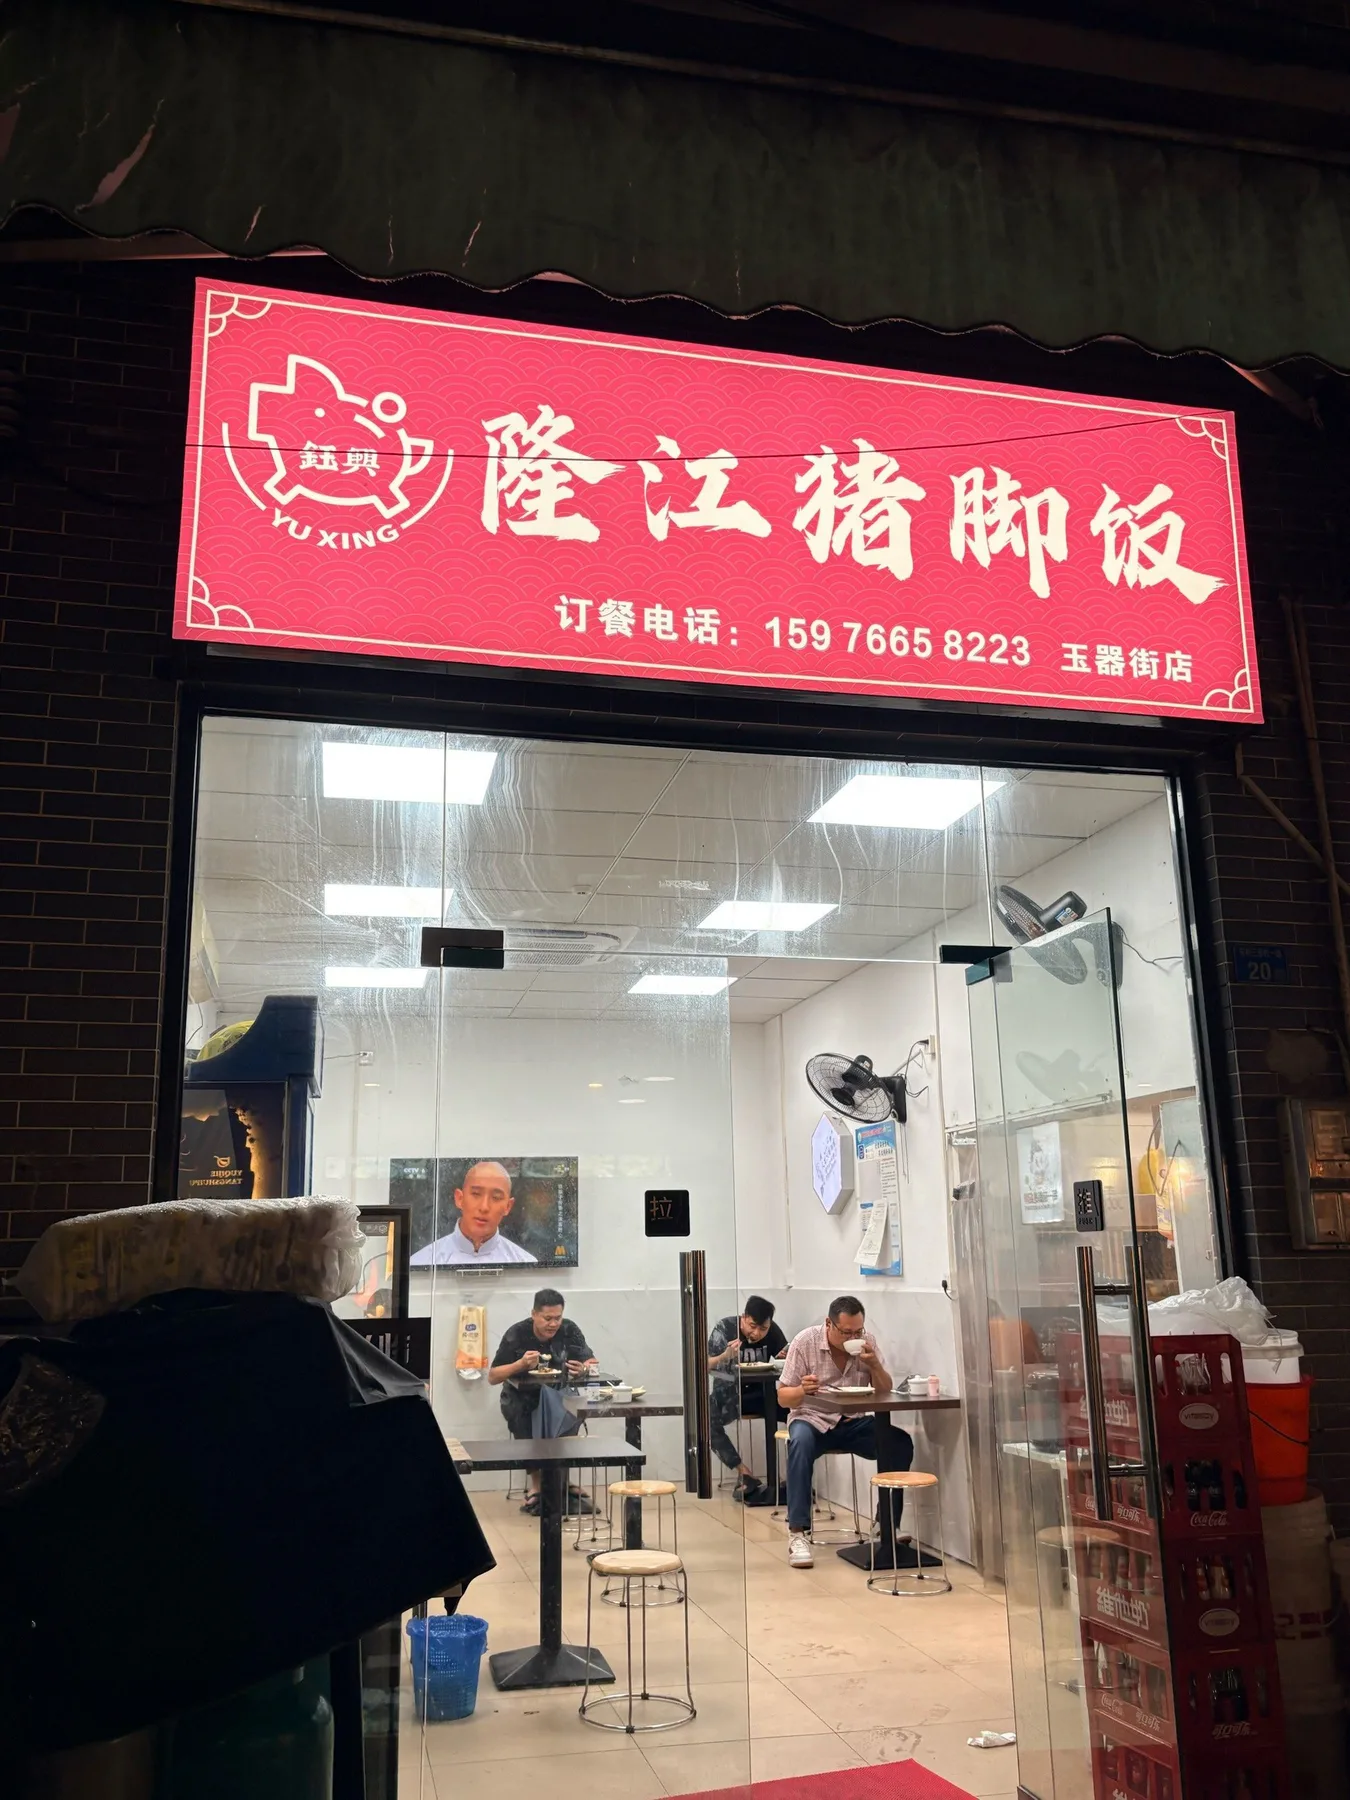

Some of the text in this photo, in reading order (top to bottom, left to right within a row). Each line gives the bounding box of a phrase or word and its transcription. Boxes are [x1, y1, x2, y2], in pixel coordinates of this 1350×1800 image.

[480, 403, 1228, 605] 隆江猪脚饭
[272, 508, 400, 550] YU XING
[765, 617, 831, 651] 159
[842, 622, 933, 659] 7665
[943, 630, 1032, 667] 8223
[1060, 642, 1193, 683] 玉器街店
[1247, 960, 1272, 981] 20
[649, 1195, 673, 1221] 拉
